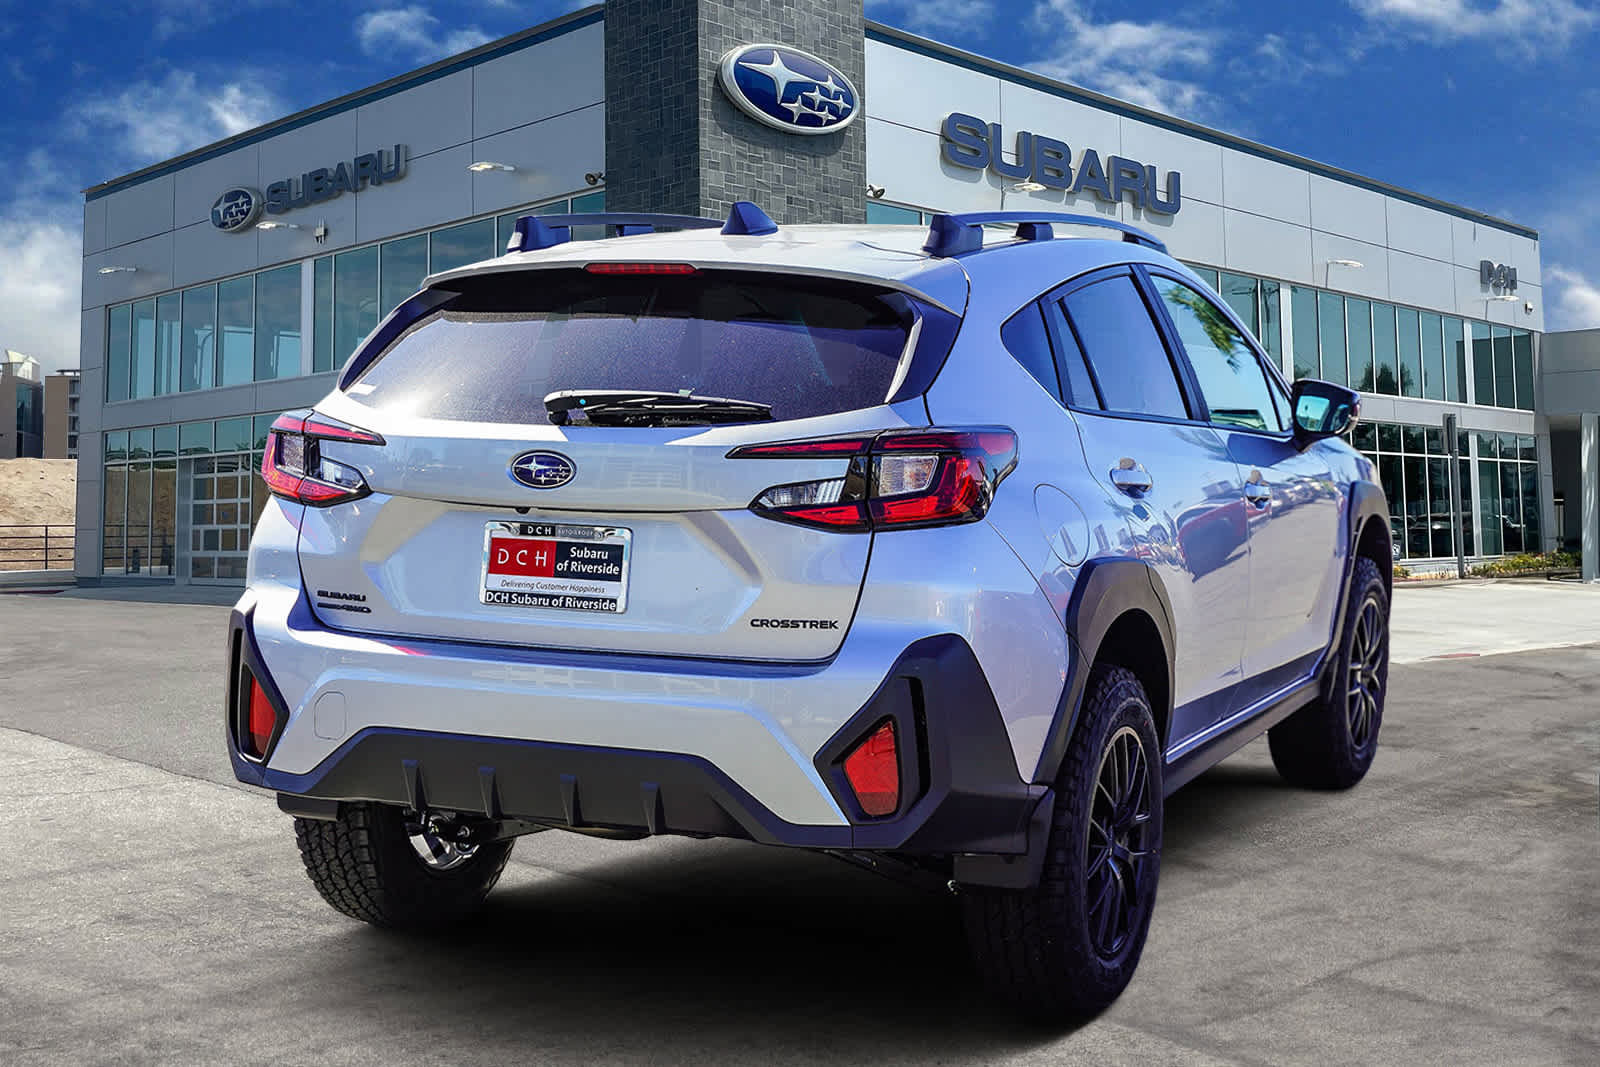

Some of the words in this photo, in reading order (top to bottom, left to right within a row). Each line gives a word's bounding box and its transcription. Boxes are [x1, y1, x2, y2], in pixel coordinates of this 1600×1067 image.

[939, 112, 1182, 215] SUBARU
[265, 144, 408, 215] SUBARU
[527, 526, 552, 535] DCH
[497, 548, 547, 567] DCH
[570, 547, 609, 560] Subaru
[556, 561, 569, 571] of
[570, 562, 620, 575] Riverside
[501, 580, 534, 591] Delivering
[535, 582, 569, 591] Customer
[569, 585, 605, 594] Happiness
[486, 592, 509, 603] DCH
[511, 595, 550, 606] Subaru
[551, 596, 564, 607] of
[565, 598, 617, 611] Riverside
[750, 618, 839, 629] CROSSTREK
